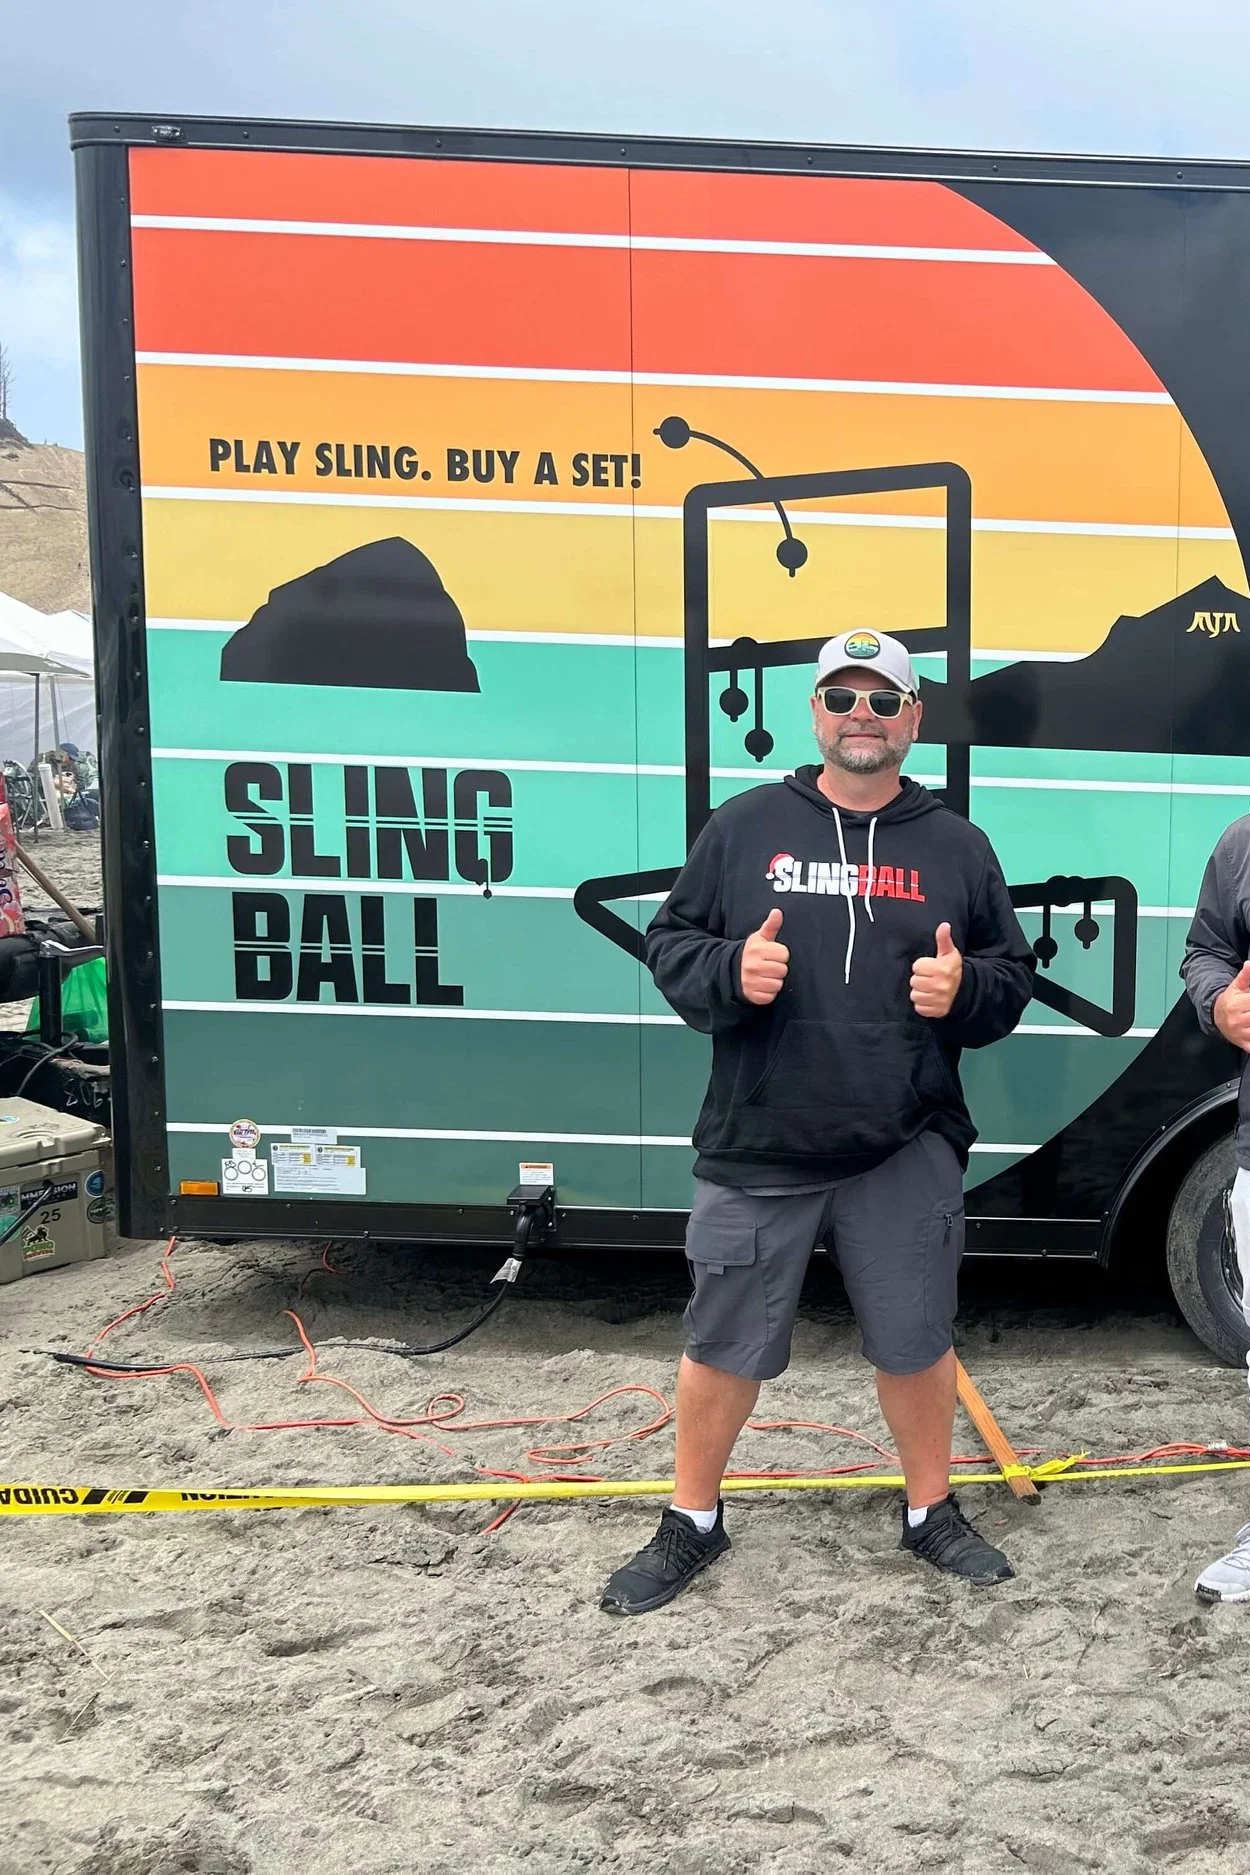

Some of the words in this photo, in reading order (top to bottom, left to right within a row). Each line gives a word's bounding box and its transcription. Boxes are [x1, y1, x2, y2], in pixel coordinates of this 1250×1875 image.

[209, 438, 300, 475] PLAY
[315, 442, 431, 481] SLING.
[447, 448, 520, 484] BUY
[534, 452, 559, 486] A
[572, 453, 641, 489] SET!
[224, 761, 514, 887] SLING
[773, 860, 926, 902] SLINGBALL
[232, 891, 465, 1006] BALL
[40, 1208, 61, 1224] 25
